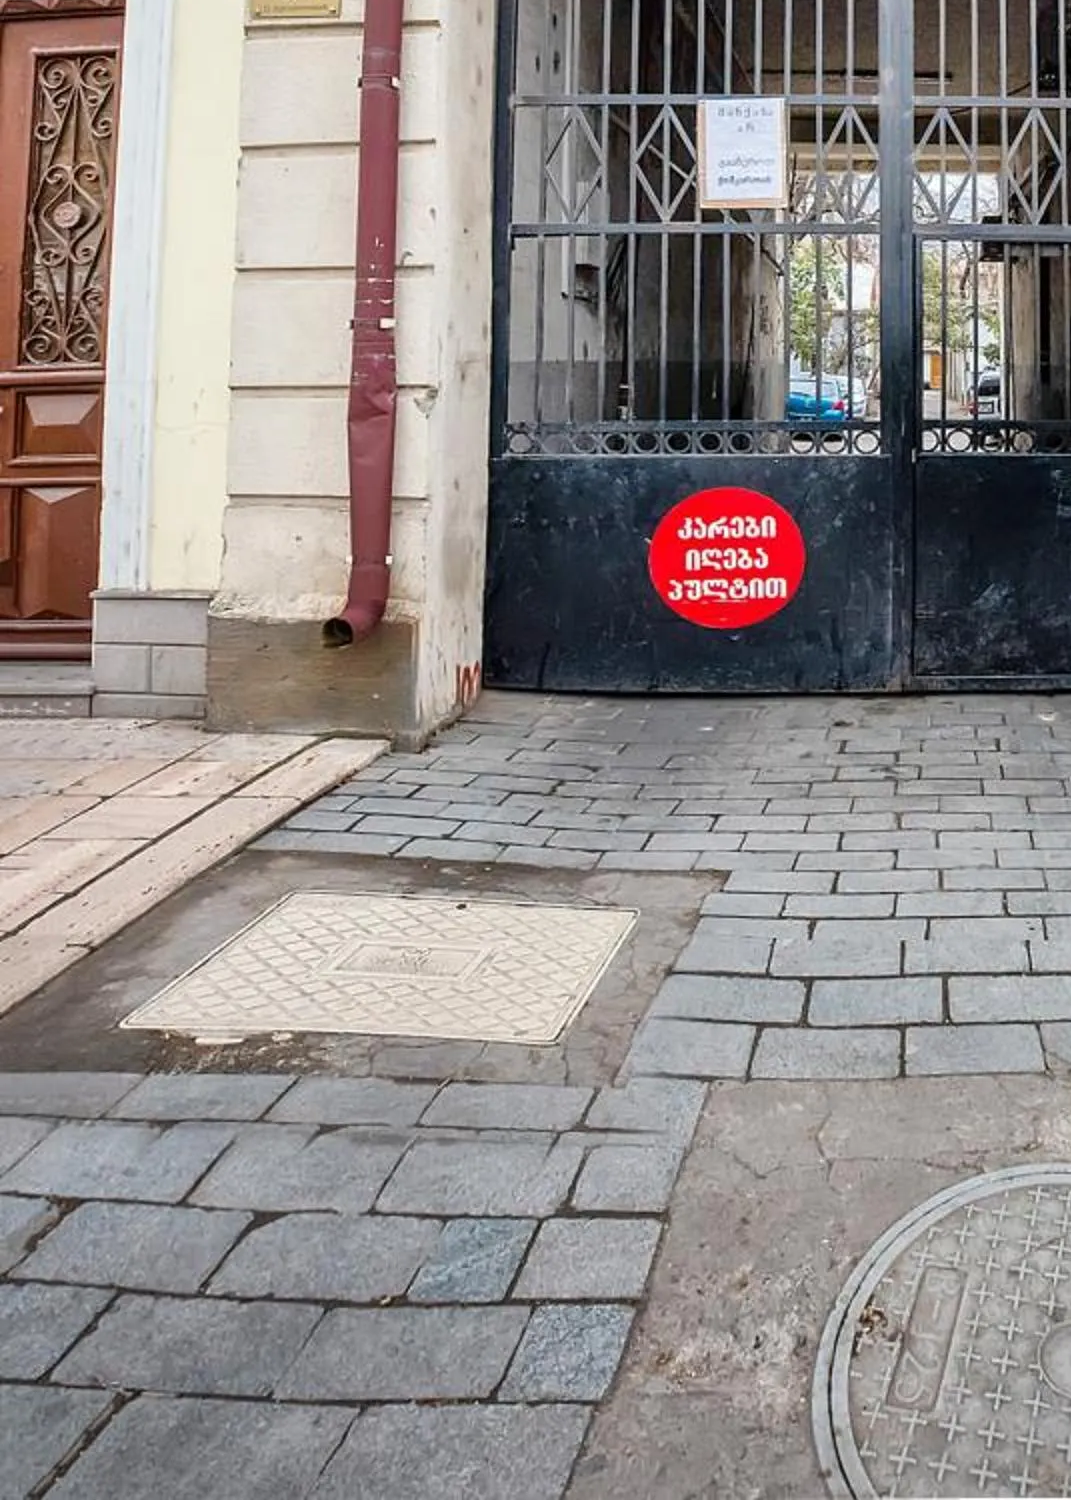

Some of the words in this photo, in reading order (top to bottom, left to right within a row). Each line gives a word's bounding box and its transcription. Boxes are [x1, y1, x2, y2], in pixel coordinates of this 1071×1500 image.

[677, 515, 777, 540] კარები
[685, 547, 769, 571] ილება
[667, 577, 787, 601] პულტით
